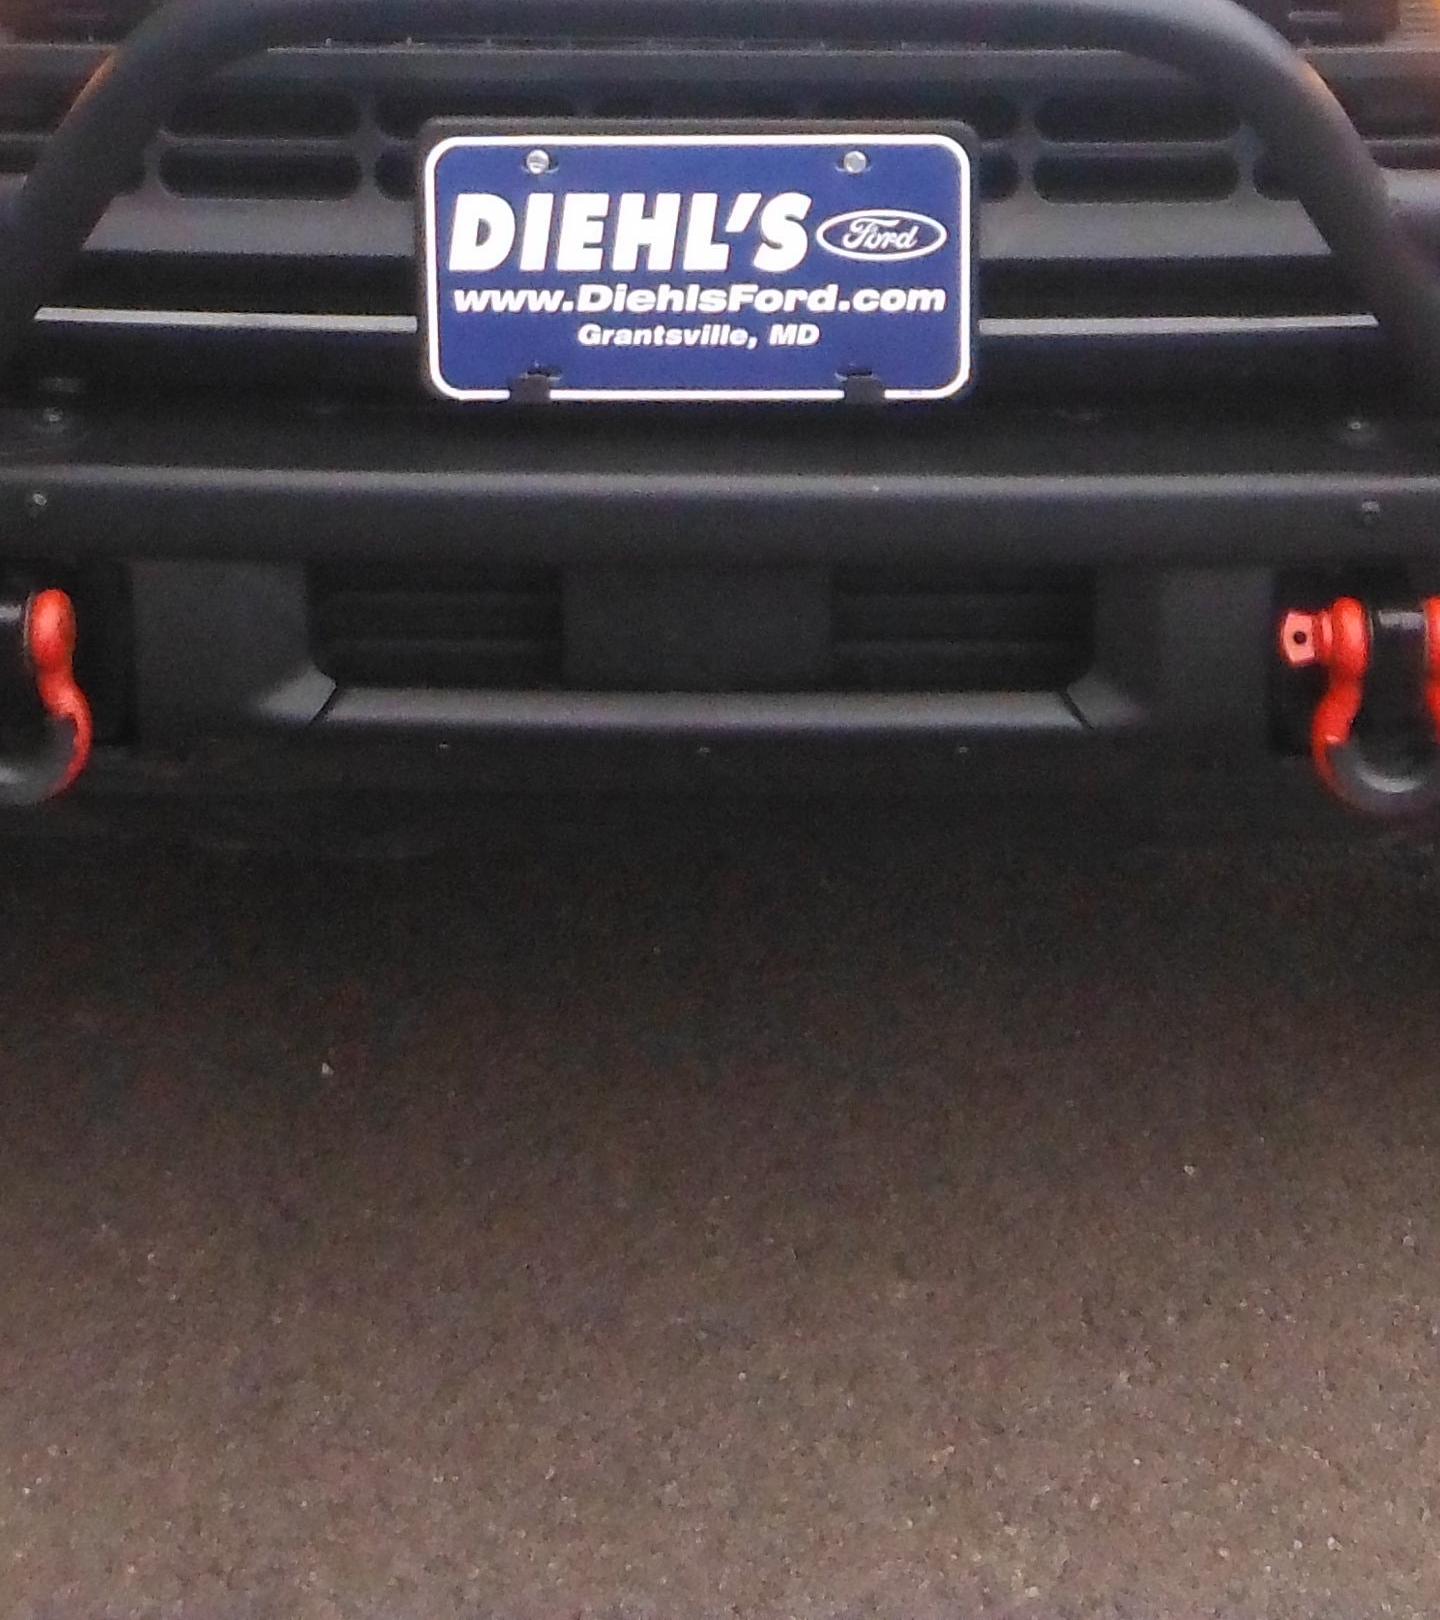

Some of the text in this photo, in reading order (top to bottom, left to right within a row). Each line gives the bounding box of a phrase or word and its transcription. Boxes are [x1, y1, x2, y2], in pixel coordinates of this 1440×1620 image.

[447, 192, 812, 273] DIEHL'S
[842, 218, 920, 249] Ford
[453, 283, 947, 313] www.DiehlsFord.com
[576, 323, 821, 349] Grantsville, MD
